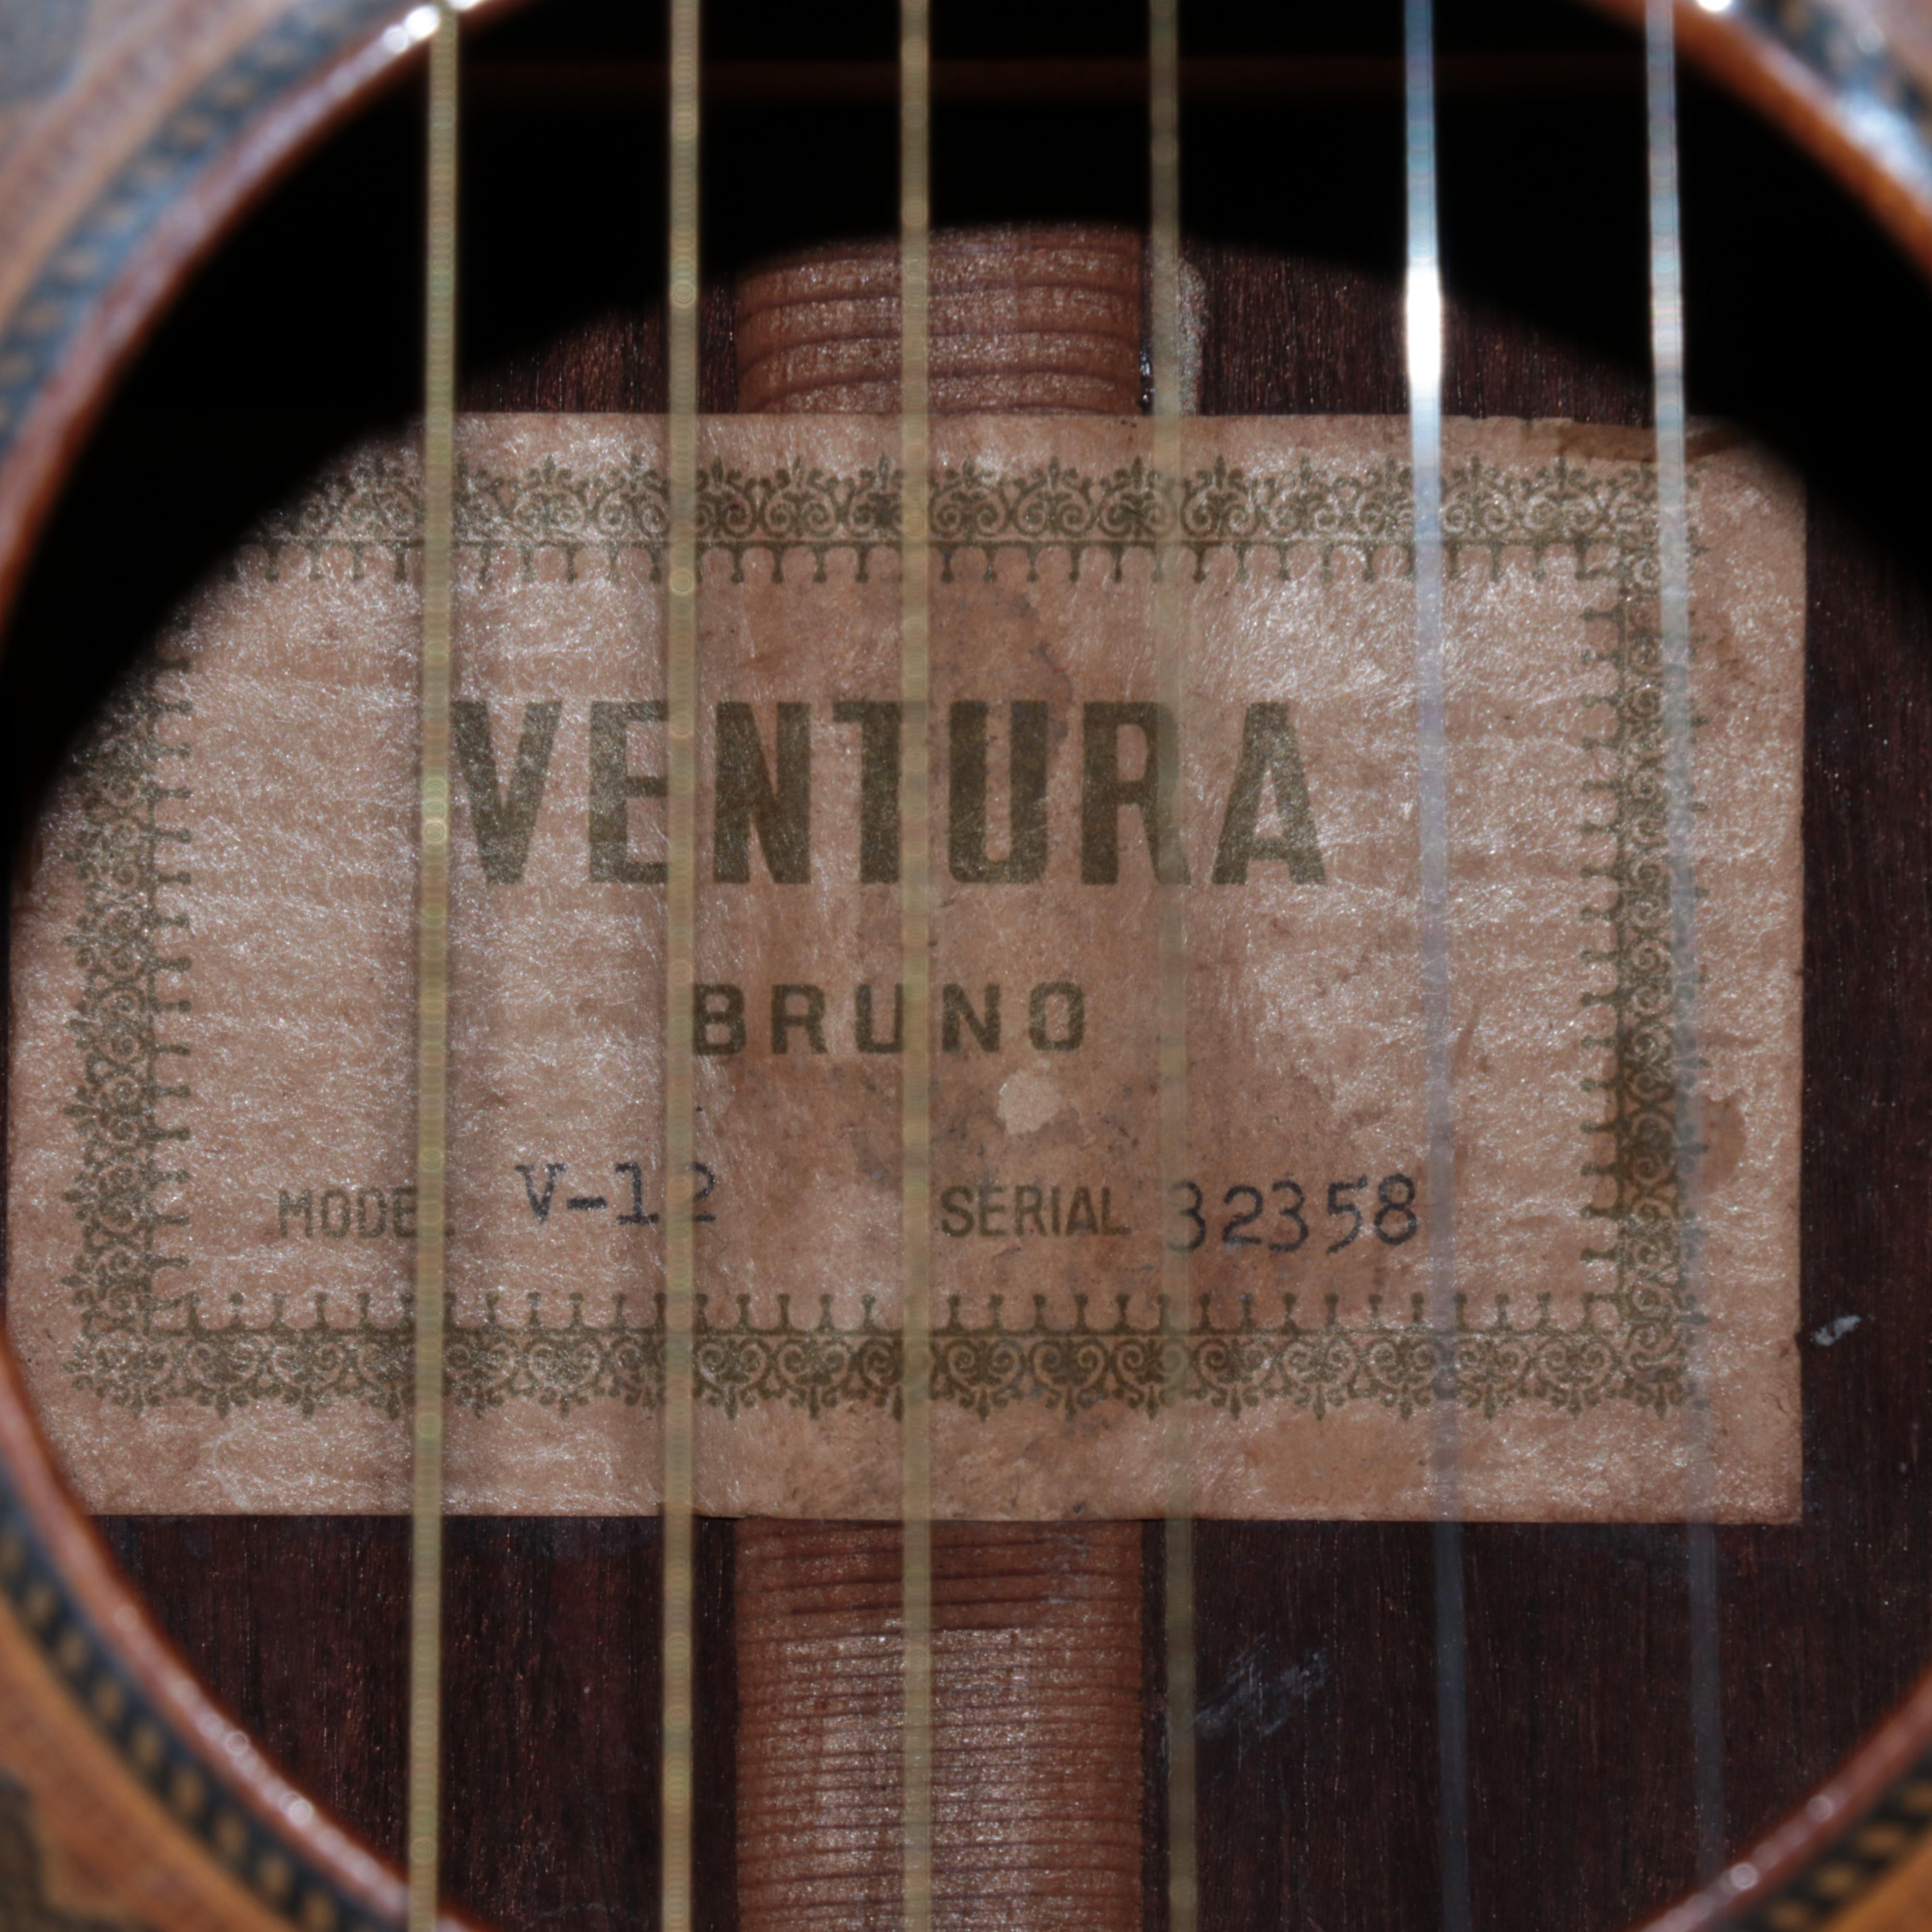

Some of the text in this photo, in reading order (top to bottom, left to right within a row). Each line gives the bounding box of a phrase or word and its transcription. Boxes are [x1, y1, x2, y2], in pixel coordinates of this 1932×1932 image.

[450, 700, 1326, 885] VENTURA
[693, 981, 1085, 1055] BRUNO
[278, 1160, 717, 1238] MODE V-12
[940, 1173, 1418, 1255] SERIAL 32358
